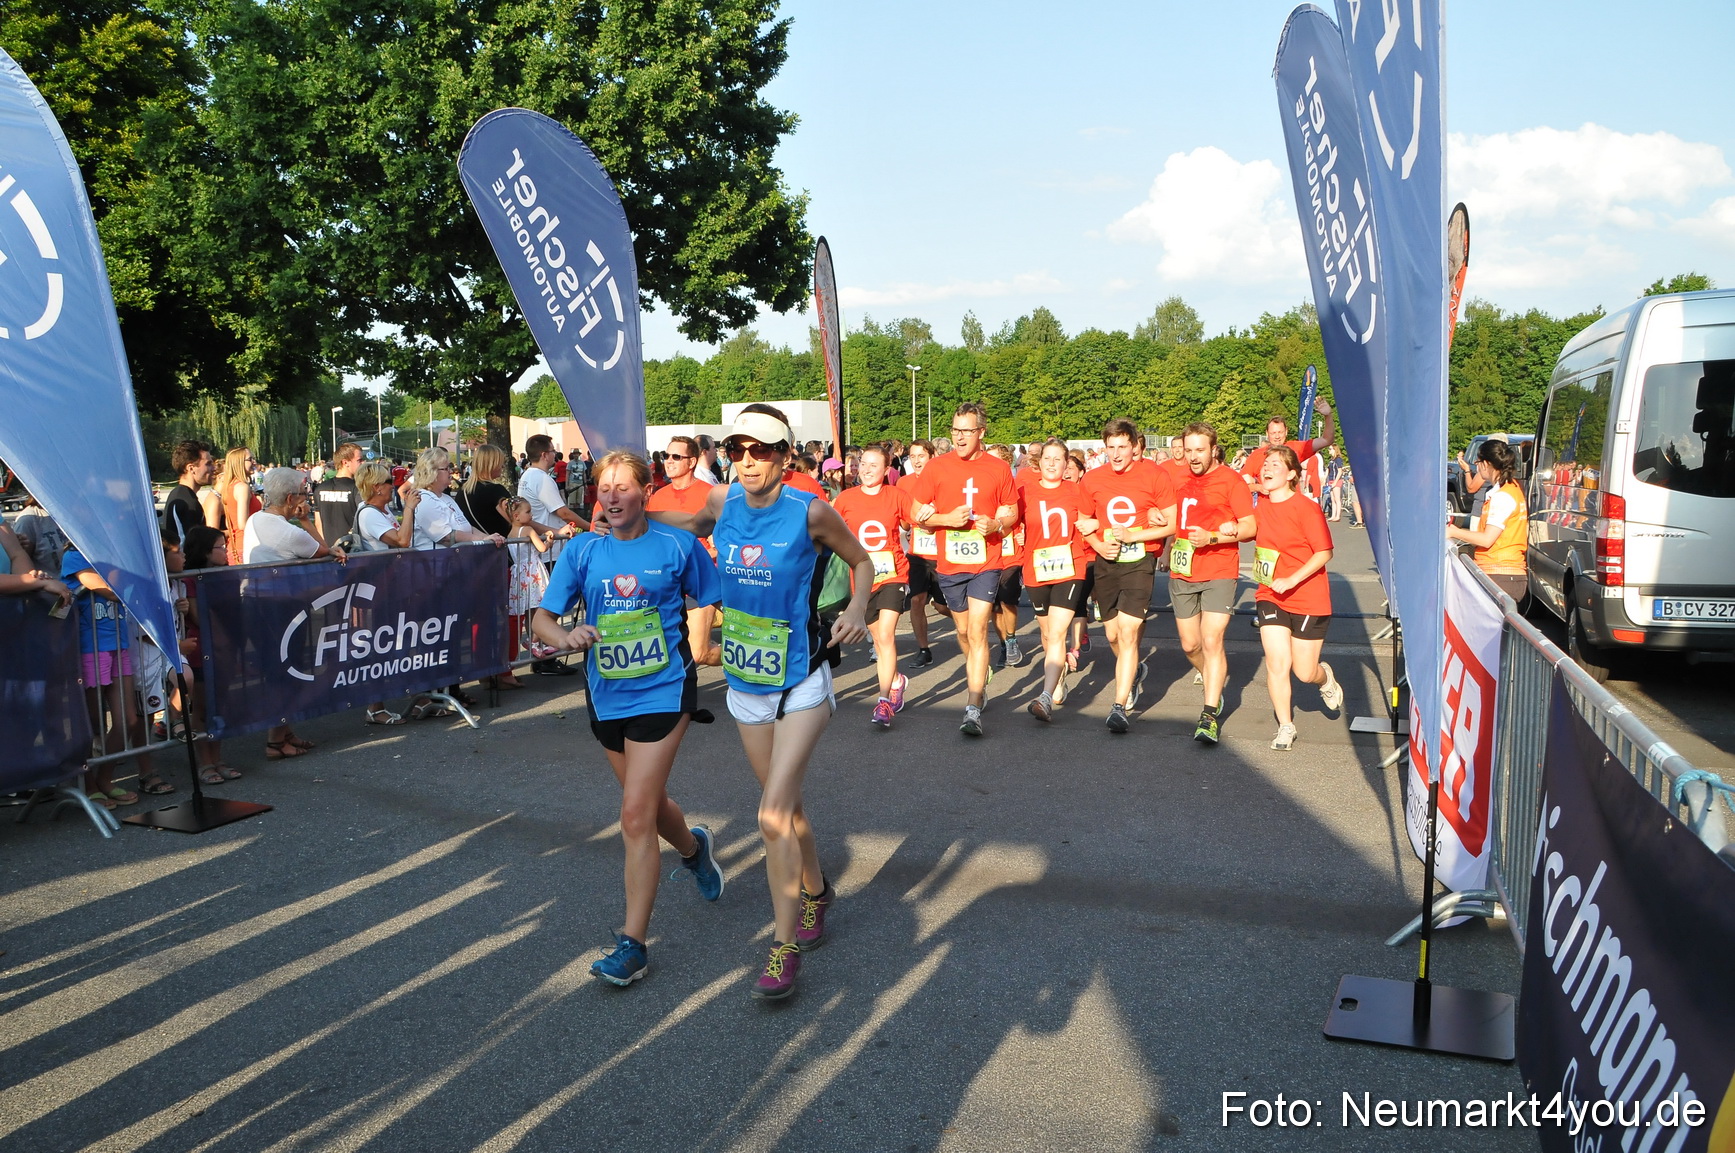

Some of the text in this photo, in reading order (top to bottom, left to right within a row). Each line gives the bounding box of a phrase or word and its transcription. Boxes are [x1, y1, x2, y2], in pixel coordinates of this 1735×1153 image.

[1038, 500, 1069, 540] h
[1106, 495, 1137, 529] e
[1181, 497, 1199, 530] r
[858, 519, 888, 552] e
[953, 541, 980, 556] 163
[725, 565, 772, 581] camping
[1172, 550, 1188, 568] 185
[604, 598, 649, 610] camping
[1663, 602, 1674, 616] B
[1684, 602, 1704, 616] CY
[314, 604, 459, 668] Fischer
[332, 649, 450, 689] AUTOMOBILE
[599, 637, 665, 671] 5044
[723, 639, 782, 676] 5043
